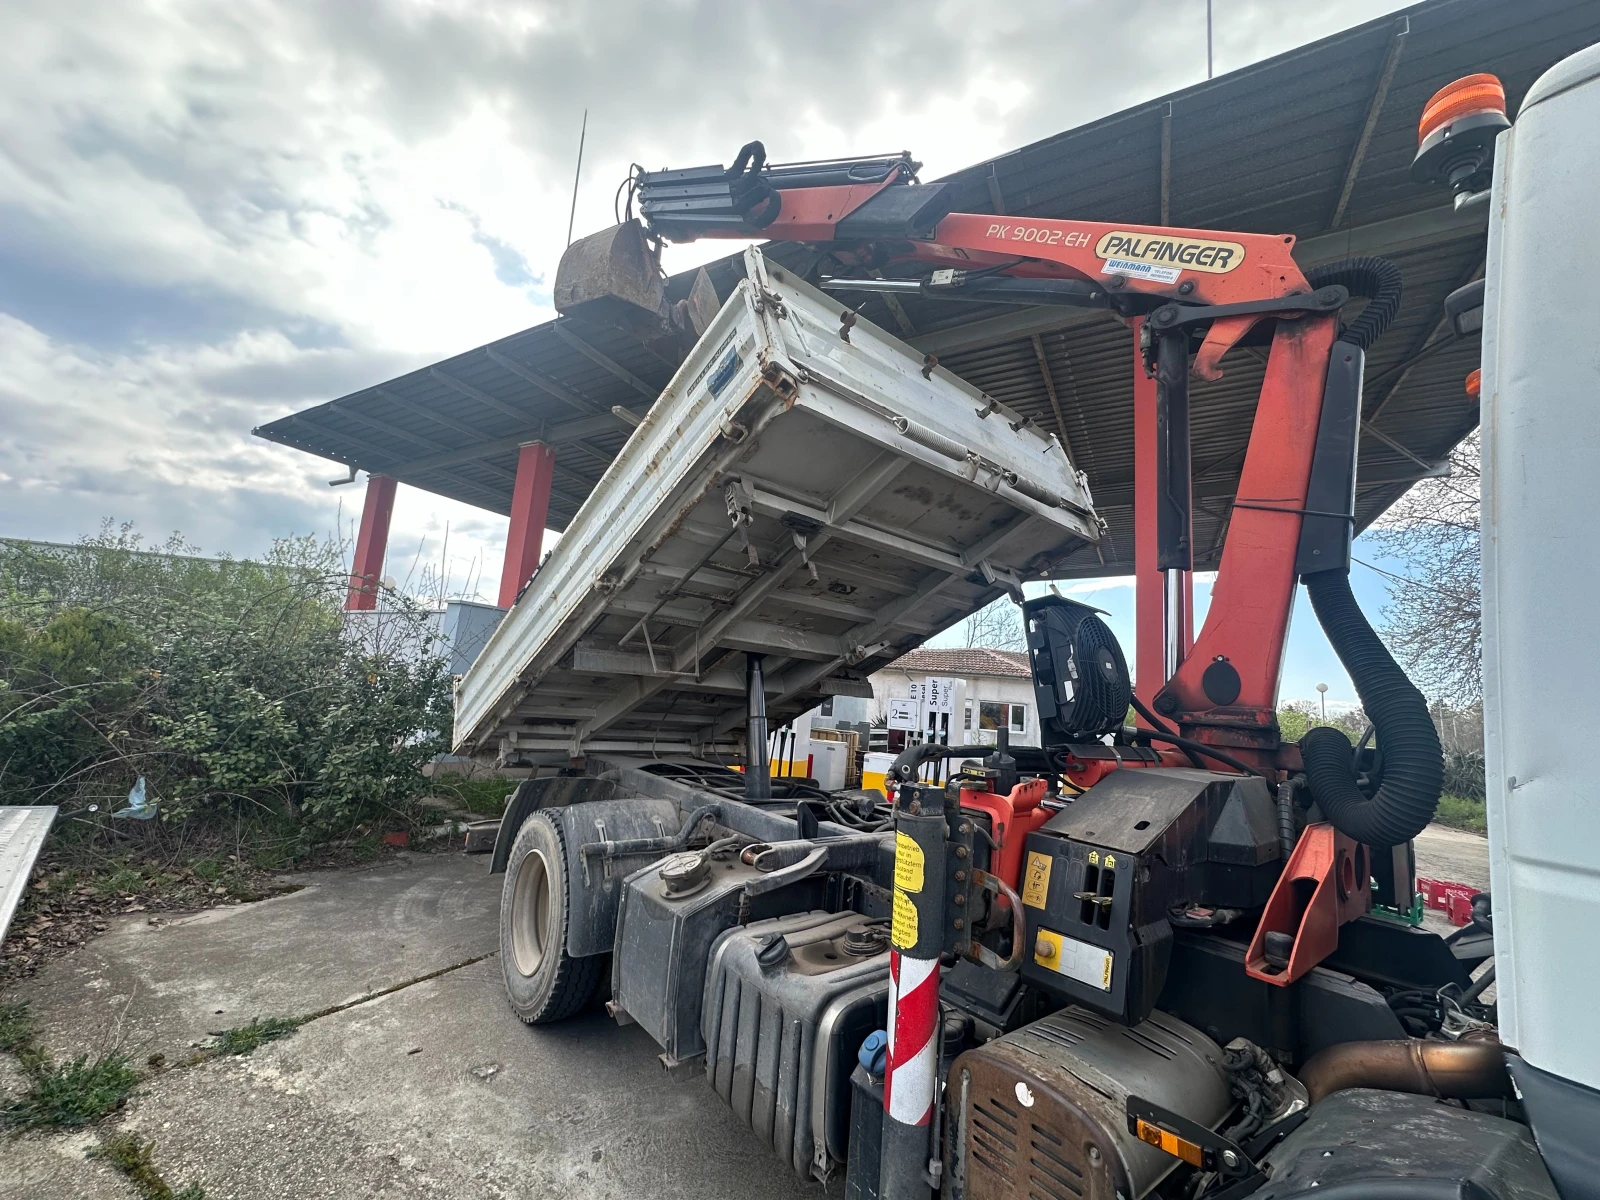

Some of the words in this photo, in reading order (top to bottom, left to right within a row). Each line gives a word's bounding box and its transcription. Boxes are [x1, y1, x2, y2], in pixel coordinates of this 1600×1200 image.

[986, 224, 1011, 239] PK
[1102, 236, 1234, 268] PALFINGER
[1108, 260, 1152, 273] WEINMANN
[930, 679, 939, 706] Super
[892, 708, 898, 719] 2
